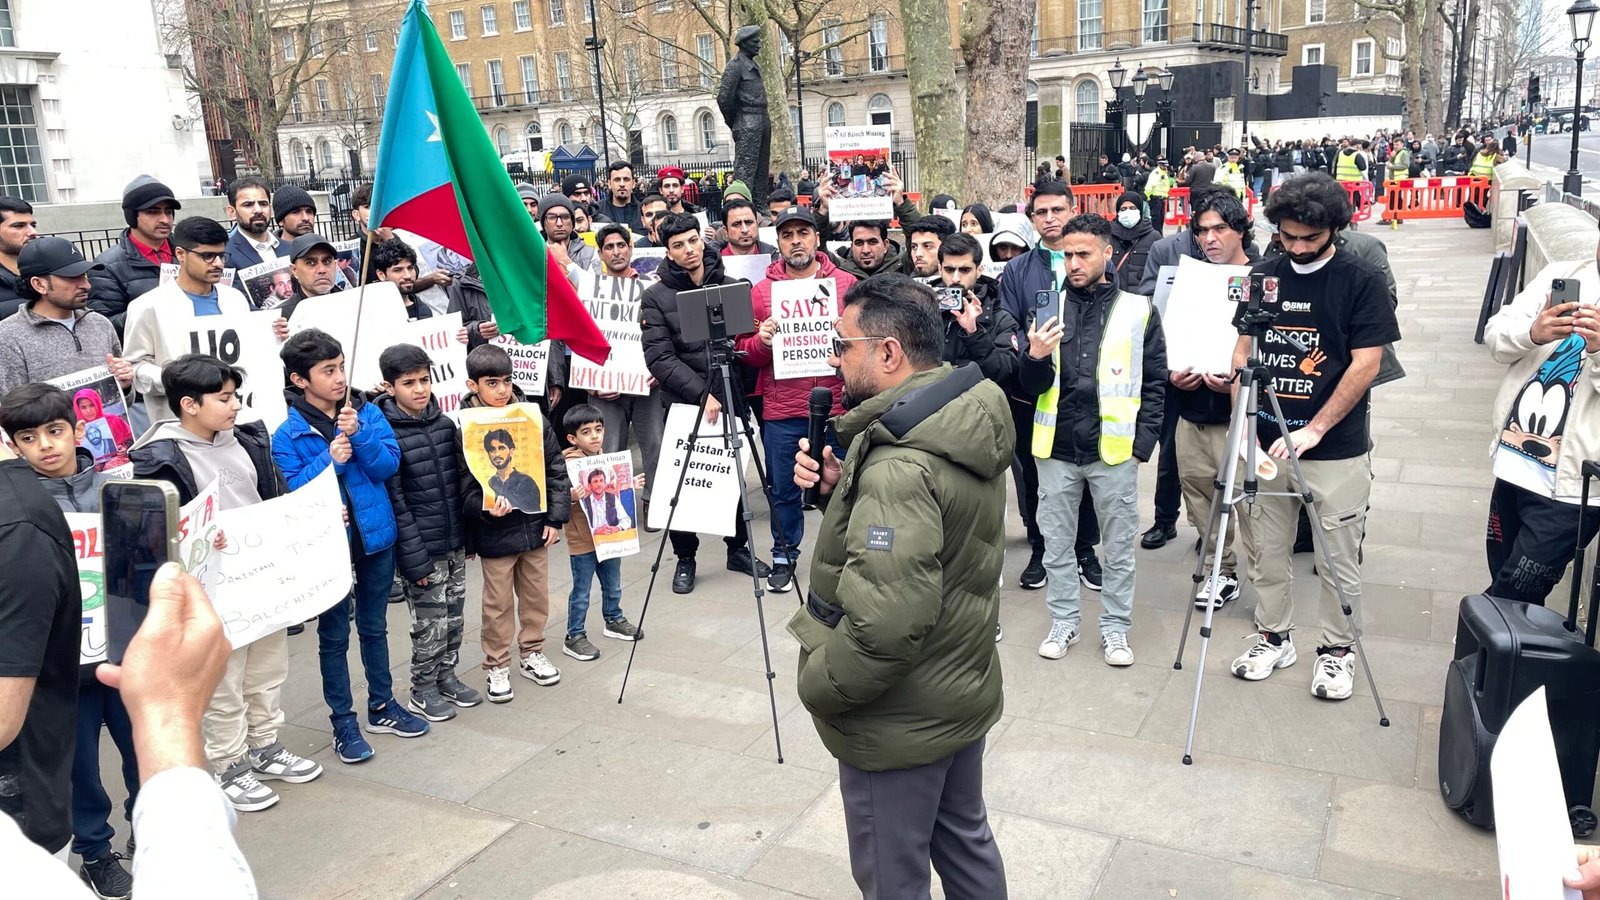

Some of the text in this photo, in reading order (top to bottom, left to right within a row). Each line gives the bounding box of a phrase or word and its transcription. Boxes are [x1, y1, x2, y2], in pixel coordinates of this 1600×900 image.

[593, 274, 645, 303] END
[780, 297, 830, 319] SAVE
[783, 334, 829, 347] MISSING
[1265, 329, 1320, 347] BALOCH
[507, 348, 547, 360] BALOCH
[782, 347, 833, 361] PERSONS
[1262, 352, 1297, 368] LIVES
[512, 359, 537, 370] SING
[511, 370, 539, 382] SONS
[1270, 376, 1313, 394] ATTER
[674, 458, 731, 475] a errorist
[684, 476, 713, 489] state
[1517, 555, 1554, 578] RESPE
